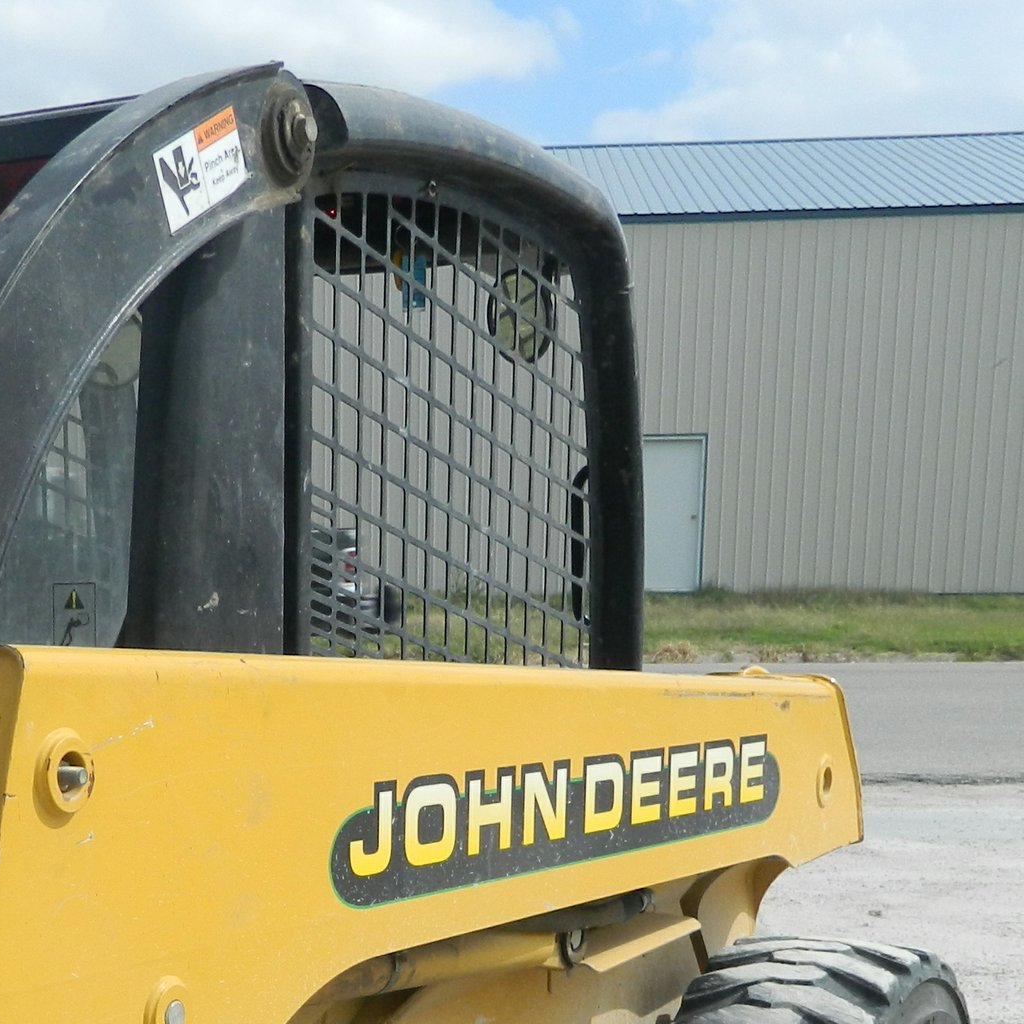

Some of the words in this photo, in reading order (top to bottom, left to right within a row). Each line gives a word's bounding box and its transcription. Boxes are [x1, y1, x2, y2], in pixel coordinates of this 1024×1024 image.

[203, 113, 234, 138] WARNING
[204, 154, 224, 172] Pinch
[224, 145, 240, 160] Area
[212, 174, 225, 186] Keep
[348, 766, 570, 877] JOHN
[584, 738, 767, 835] DEERE
